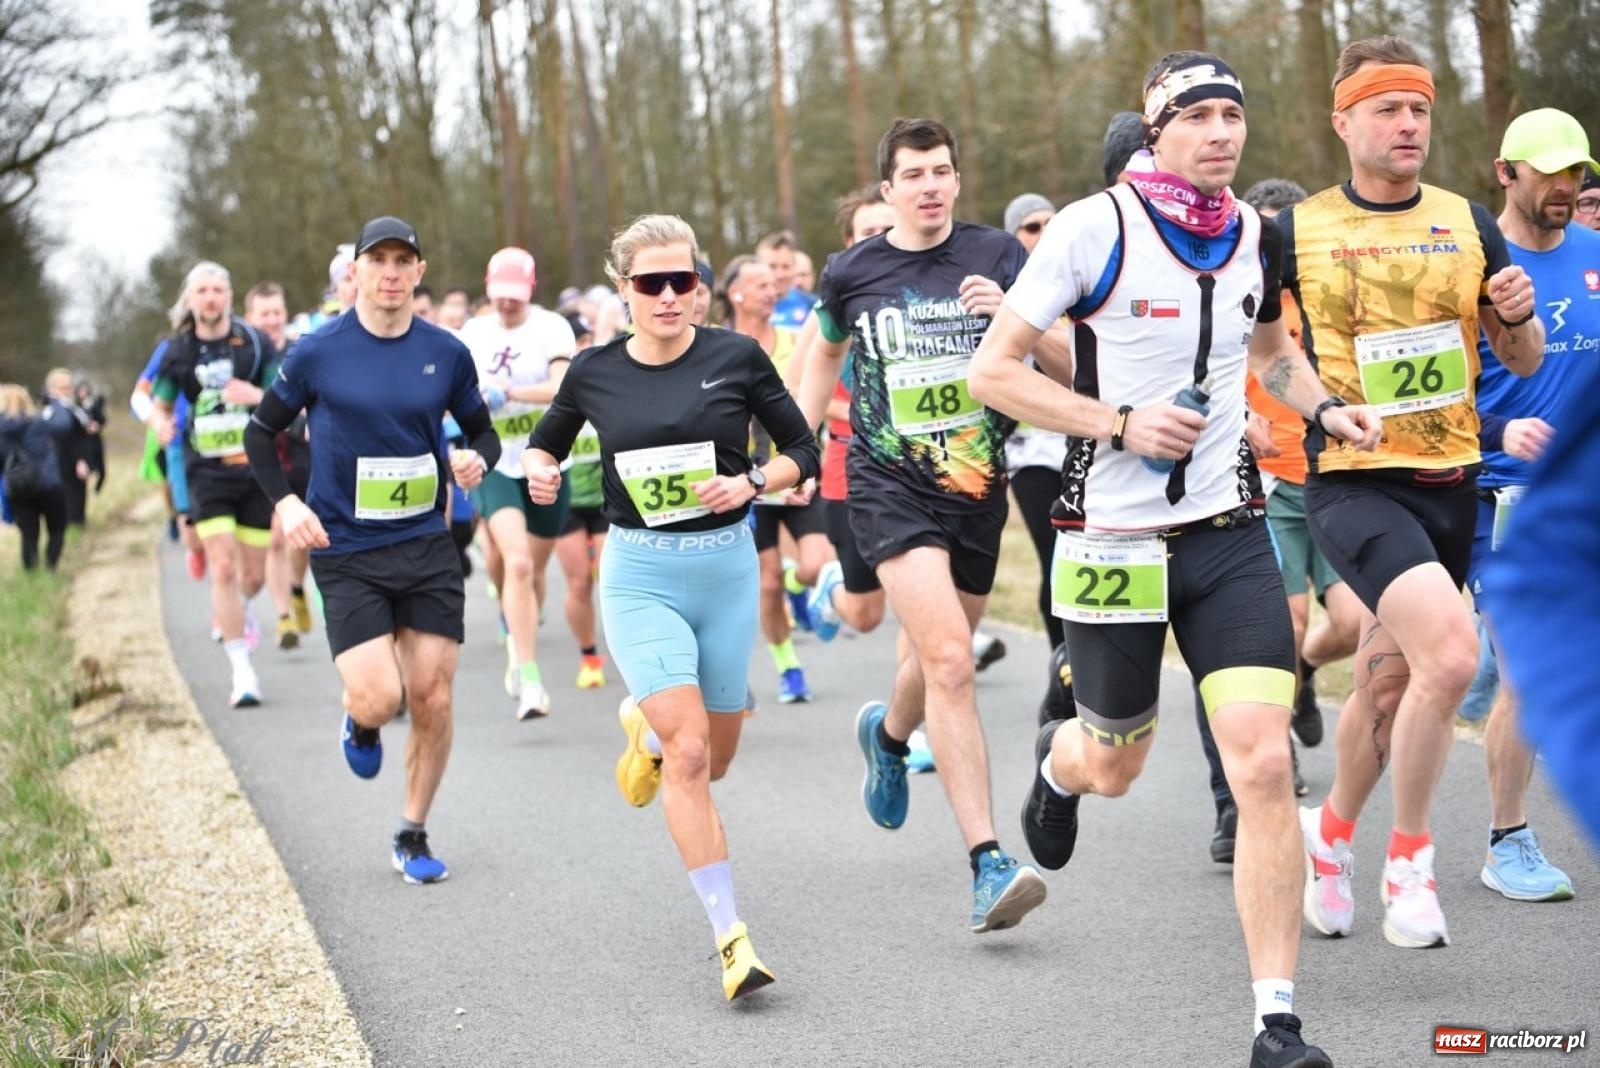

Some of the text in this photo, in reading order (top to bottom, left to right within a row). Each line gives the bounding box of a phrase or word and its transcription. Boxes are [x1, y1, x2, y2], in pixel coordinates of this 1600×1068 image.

[855, 307, 907, 361] 10
[1392, 356, 1444, 399] 26
[916, 384, 961, 418] 48
[505, 413, 533, 436] 40
[390, 481, 409, 506] 4
[642, 474, 688, 512] 35
[615, 527, 736, 551] NIKE PRO
[1075, 566, 1131, 607] 22
